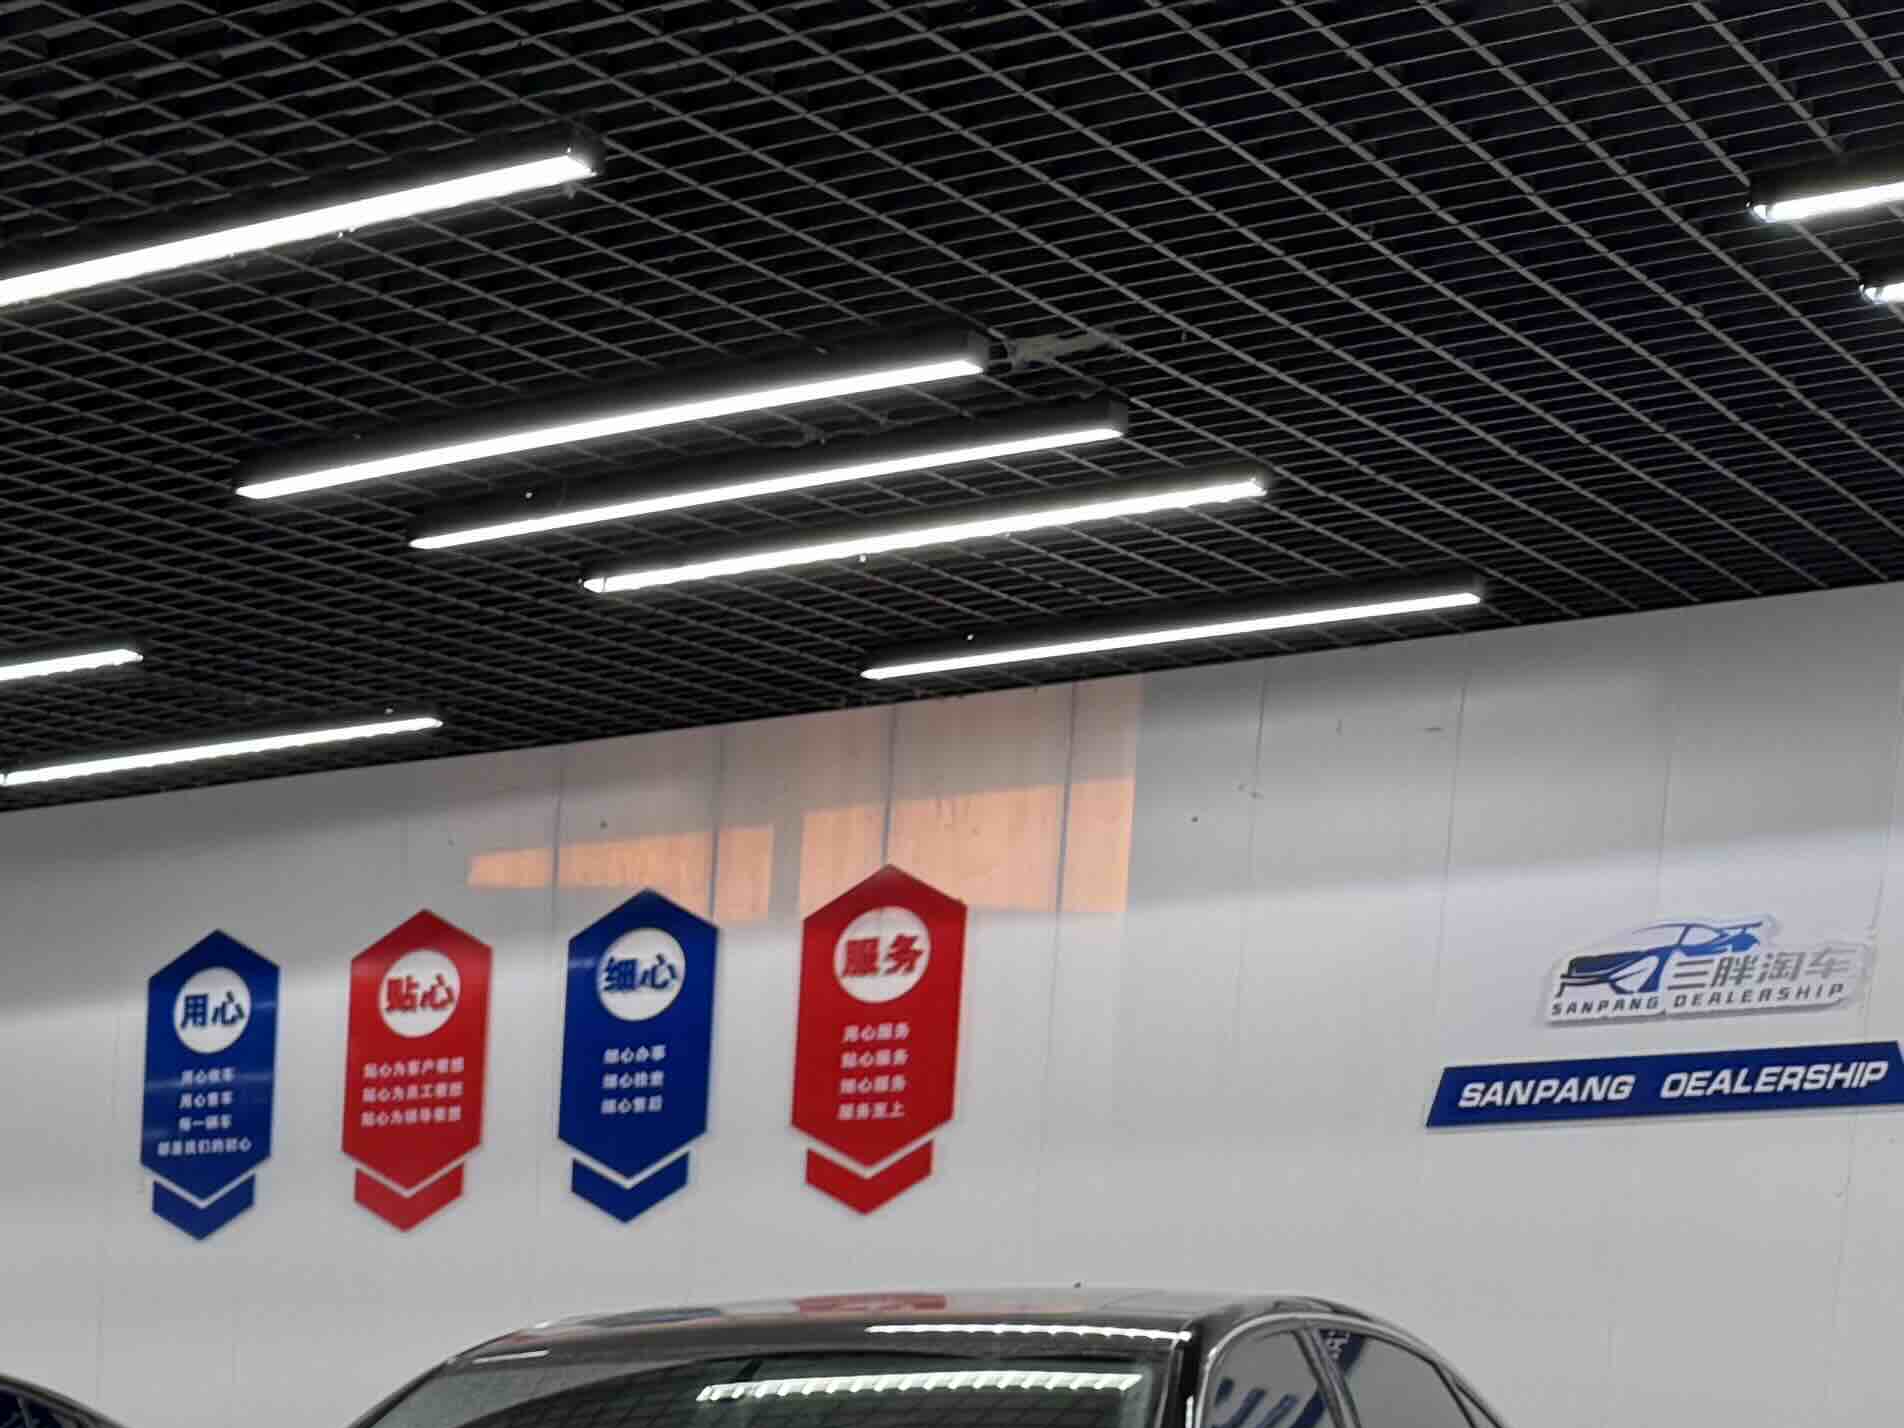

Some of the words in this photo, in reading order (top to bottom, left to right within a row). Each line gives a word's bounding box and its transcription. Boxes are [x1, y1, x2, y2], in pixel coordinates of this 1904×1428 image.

[603, 954, 678, 993] 细心
[841, 934, 924, 977] 服务
[1667, 948, 1852, 990] 三胖淘车
[180, 991, 246, 1030] 用心
[385, 974, 455, 1014] 贴心
[1551, 995, 1659, 1016] SANPANG
[1673, 983, 1844, 1008] DEALERSHIP
[1458, 1074, 1636, 1109] SANPANG
[1660, 1061, 1889, 1099] DEALERSHIP
